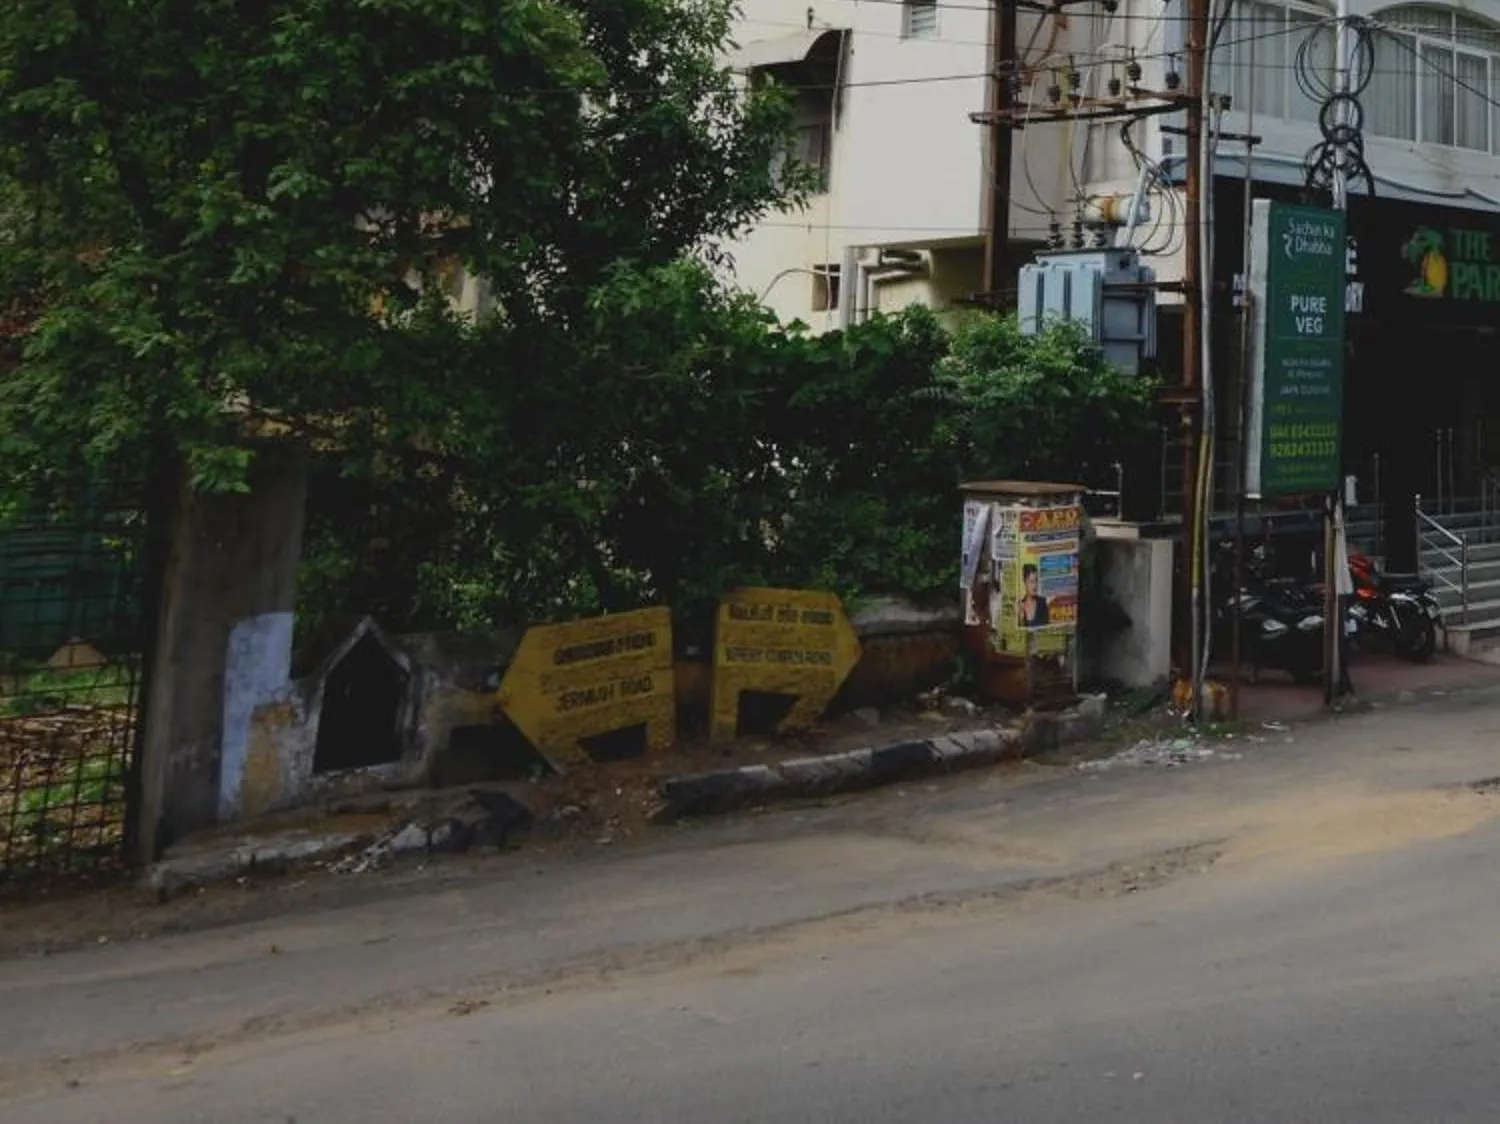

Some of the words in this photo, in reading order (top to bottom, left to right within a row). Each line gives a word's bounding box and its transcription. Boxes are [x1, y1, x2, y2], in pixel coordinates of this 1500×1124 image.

[1449, 229, 1493, 261] THE
[1290, 295, 1328, 314] PURE
[1295, 316, 1324, 334] VEG
